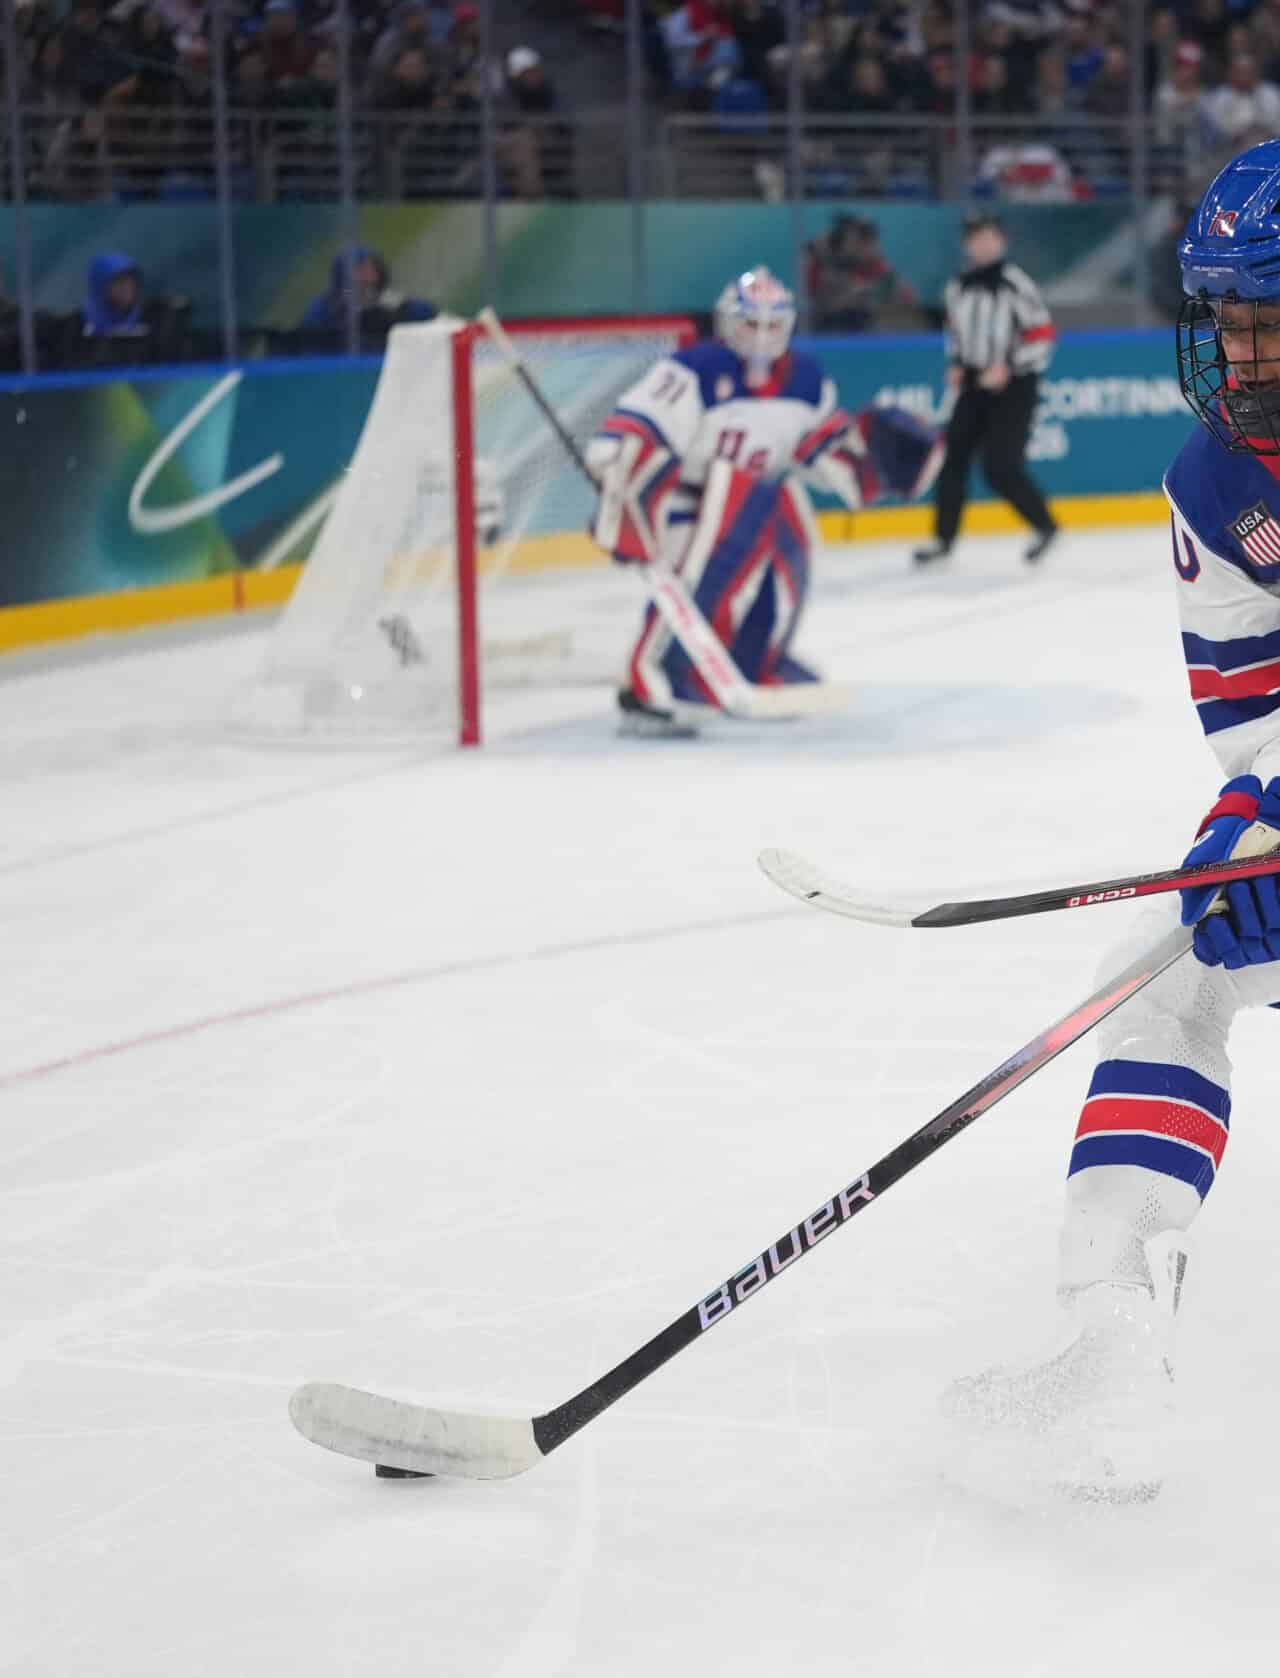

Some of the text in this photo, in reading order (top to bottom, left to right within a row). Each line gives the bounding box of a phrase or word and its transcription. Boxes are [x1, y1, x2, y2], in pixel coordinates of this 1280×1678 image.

[1235, 511, 1265, 536] USA
[1086, 886, 1137, 906] CCM
[697, 1172, 875, 1330] BAUER
